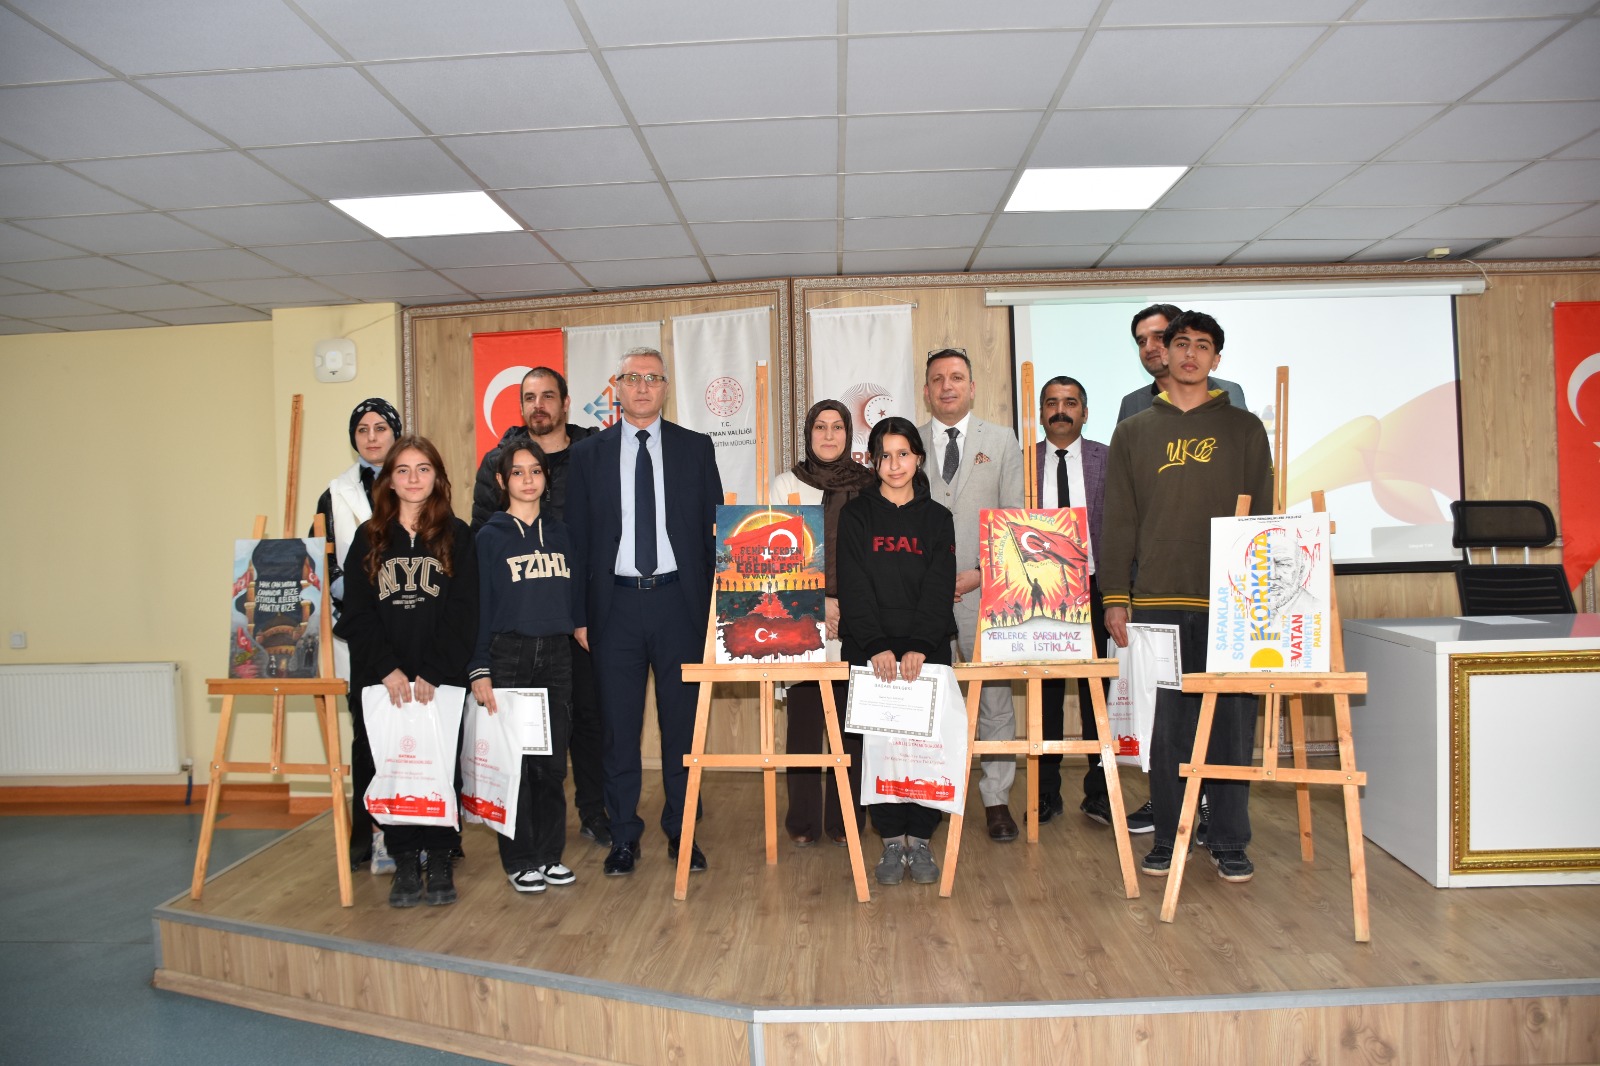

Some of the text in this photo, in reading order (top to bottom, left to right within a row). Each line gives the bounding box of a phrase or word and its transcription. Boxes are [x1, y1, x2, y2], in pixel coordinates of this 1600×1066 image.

[1029, 512, 1055, 526] HÜR
[872, 535, 923, 555] FSAL
[378, 556, 444, 601] NYC
[987, 631, 1081, 641] YERLERDE SARSILMAZ
[1290, 614, 1303, 661] VATAN
[1011, 641, 1025, 652] BİR
